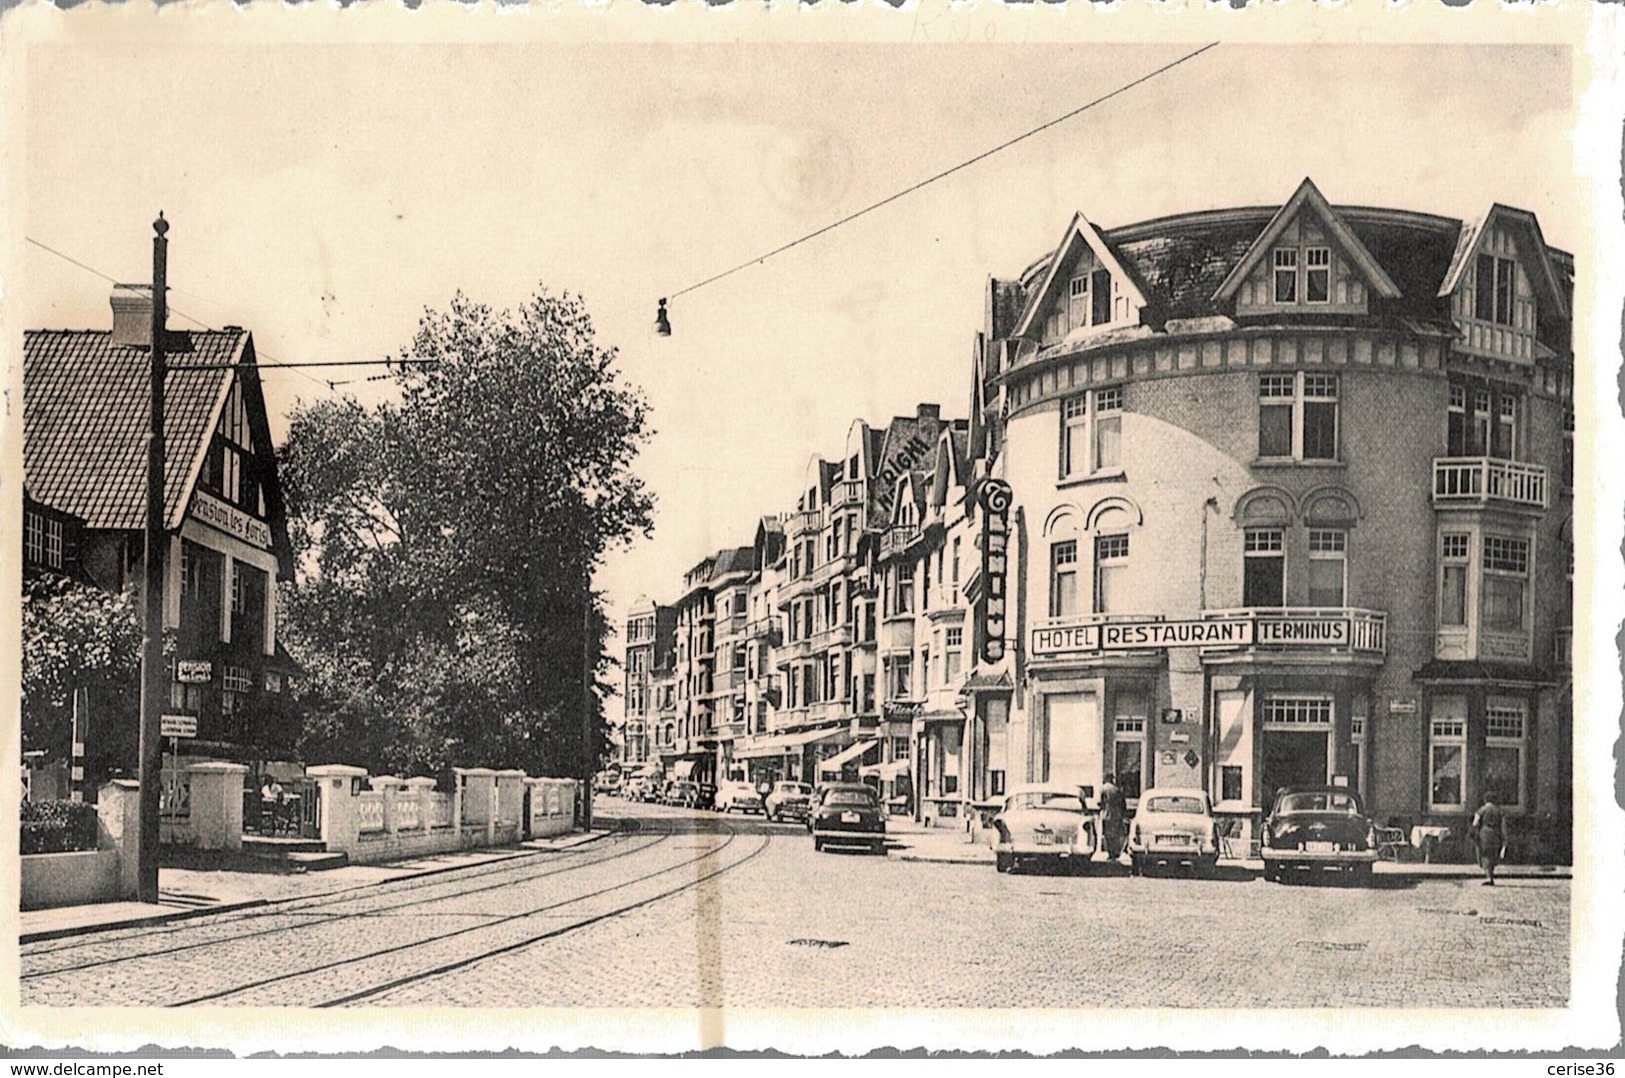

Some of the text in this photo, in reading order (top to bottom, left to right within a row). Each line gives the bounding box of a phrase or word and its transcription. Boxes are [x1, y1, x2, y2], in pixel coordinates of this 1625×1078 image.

[977, 480, 1011, 660] TERMINUS
[1039, 621, 1343, 649] HOTEL RESTAURANT TERMINUS
